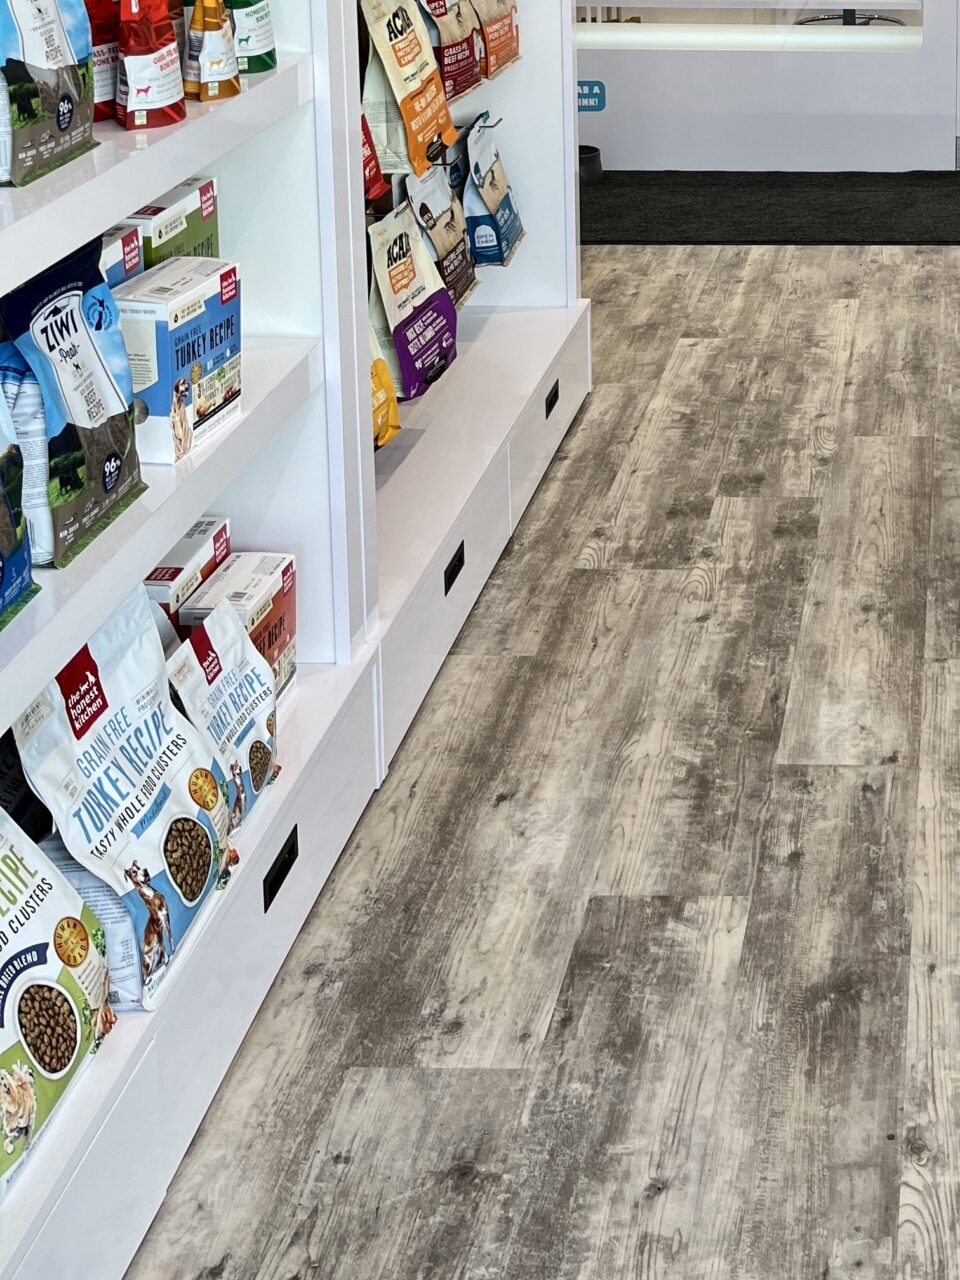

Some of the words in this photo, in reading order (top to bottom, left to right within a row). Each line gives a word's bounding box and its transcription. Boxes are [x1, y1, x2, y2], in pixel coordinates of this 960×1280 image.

[429, 0, 445, 12] OPEN
[444, 55, 457, 65] BEEF
[593, 85, 600, 94] A
[58, 98, 73, 114] 96%
[477, 232, 494, 240] OPEN
[40, 308, 79, 353] ZIWI
[175, 329, 191, 347] GRAIN
[190, 323, 202, 340] FREE
[175, 336, 206, 371] TURKEY
[210, 315, 235, 350] RECIPE
[104, 456, 121, 476] 96%
[267, 612, 288, 650] RECIPE
[68, 690, 81, 708] the
[70, 685, 99, 719] honest
[135, 681, 159, 706] MINIMALLY
[207, 684, 224, 708] GRAIN
[221, 669, 239, 696] FREE
[246, 686, 273, 718] CLUSTERS
[73, 697, 103, 731] kitchen
[206, 703, 234, 746] TURKEY
[229, 667, 266, 714] RECIPE
[76, 731, 112, 779] GRAIN
[102, 705, 132, 746] FREE
[72, 755, 137, 845] TURKEY
[118, 700, 174, 777] RECIPE
[90, 830, 118, 860] TASTY
[114, 793, 146, 834] WHOLE
[140, 769, 158, 801] FOOD
[150, 733, 188, 784] CLUSTERS
[8, 876, 54, 936] CLUSTERS
[56, 922, 78, 949] HUMAN
[13, 950, 38, 971] BLEND
